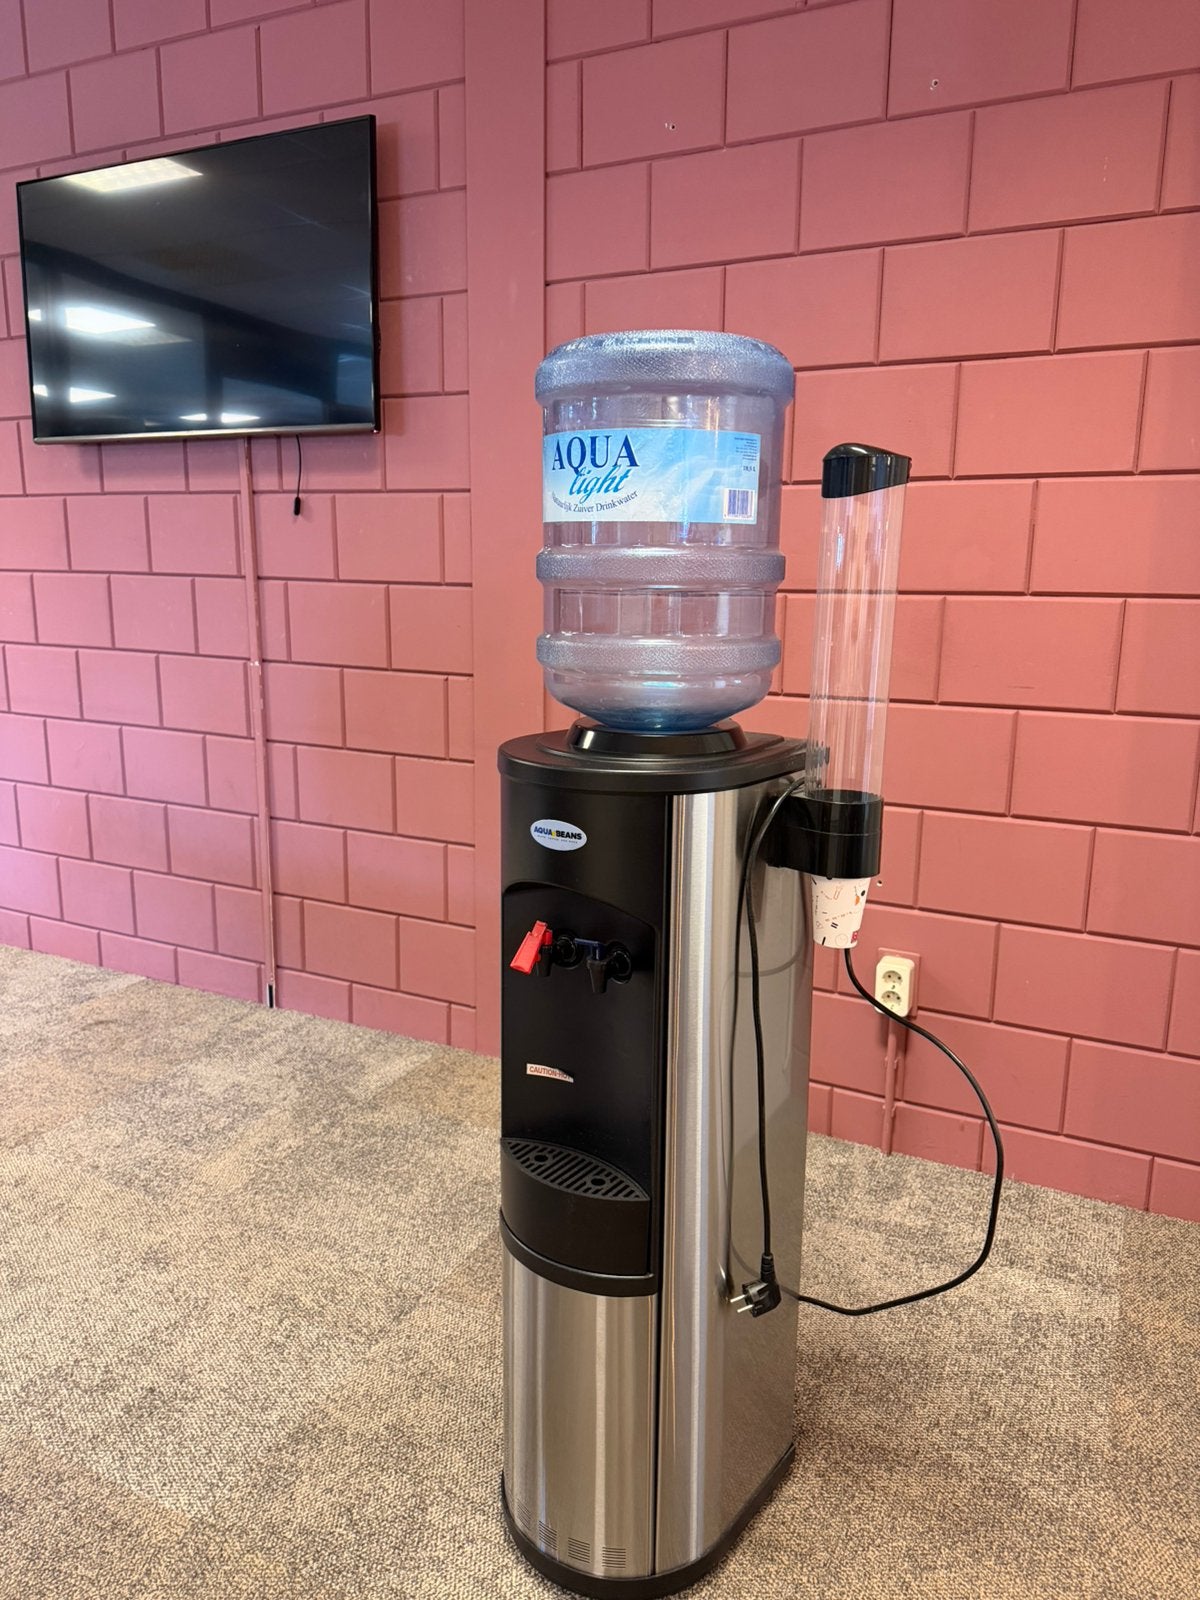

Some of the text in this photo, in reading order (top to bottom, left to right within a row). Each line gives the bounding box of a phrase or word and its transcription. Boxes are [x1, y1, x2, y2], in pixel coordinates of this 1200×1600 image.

[552, 435, 640, 475] AQUA
[569, 465, 632, 504] light
[573, 503, 595, 513] Zuiver
[595, 490, 638, 512] Drinkwater
[534, 826, 552, 836] AQUA
[556, 830, 582, 840] BEANS
